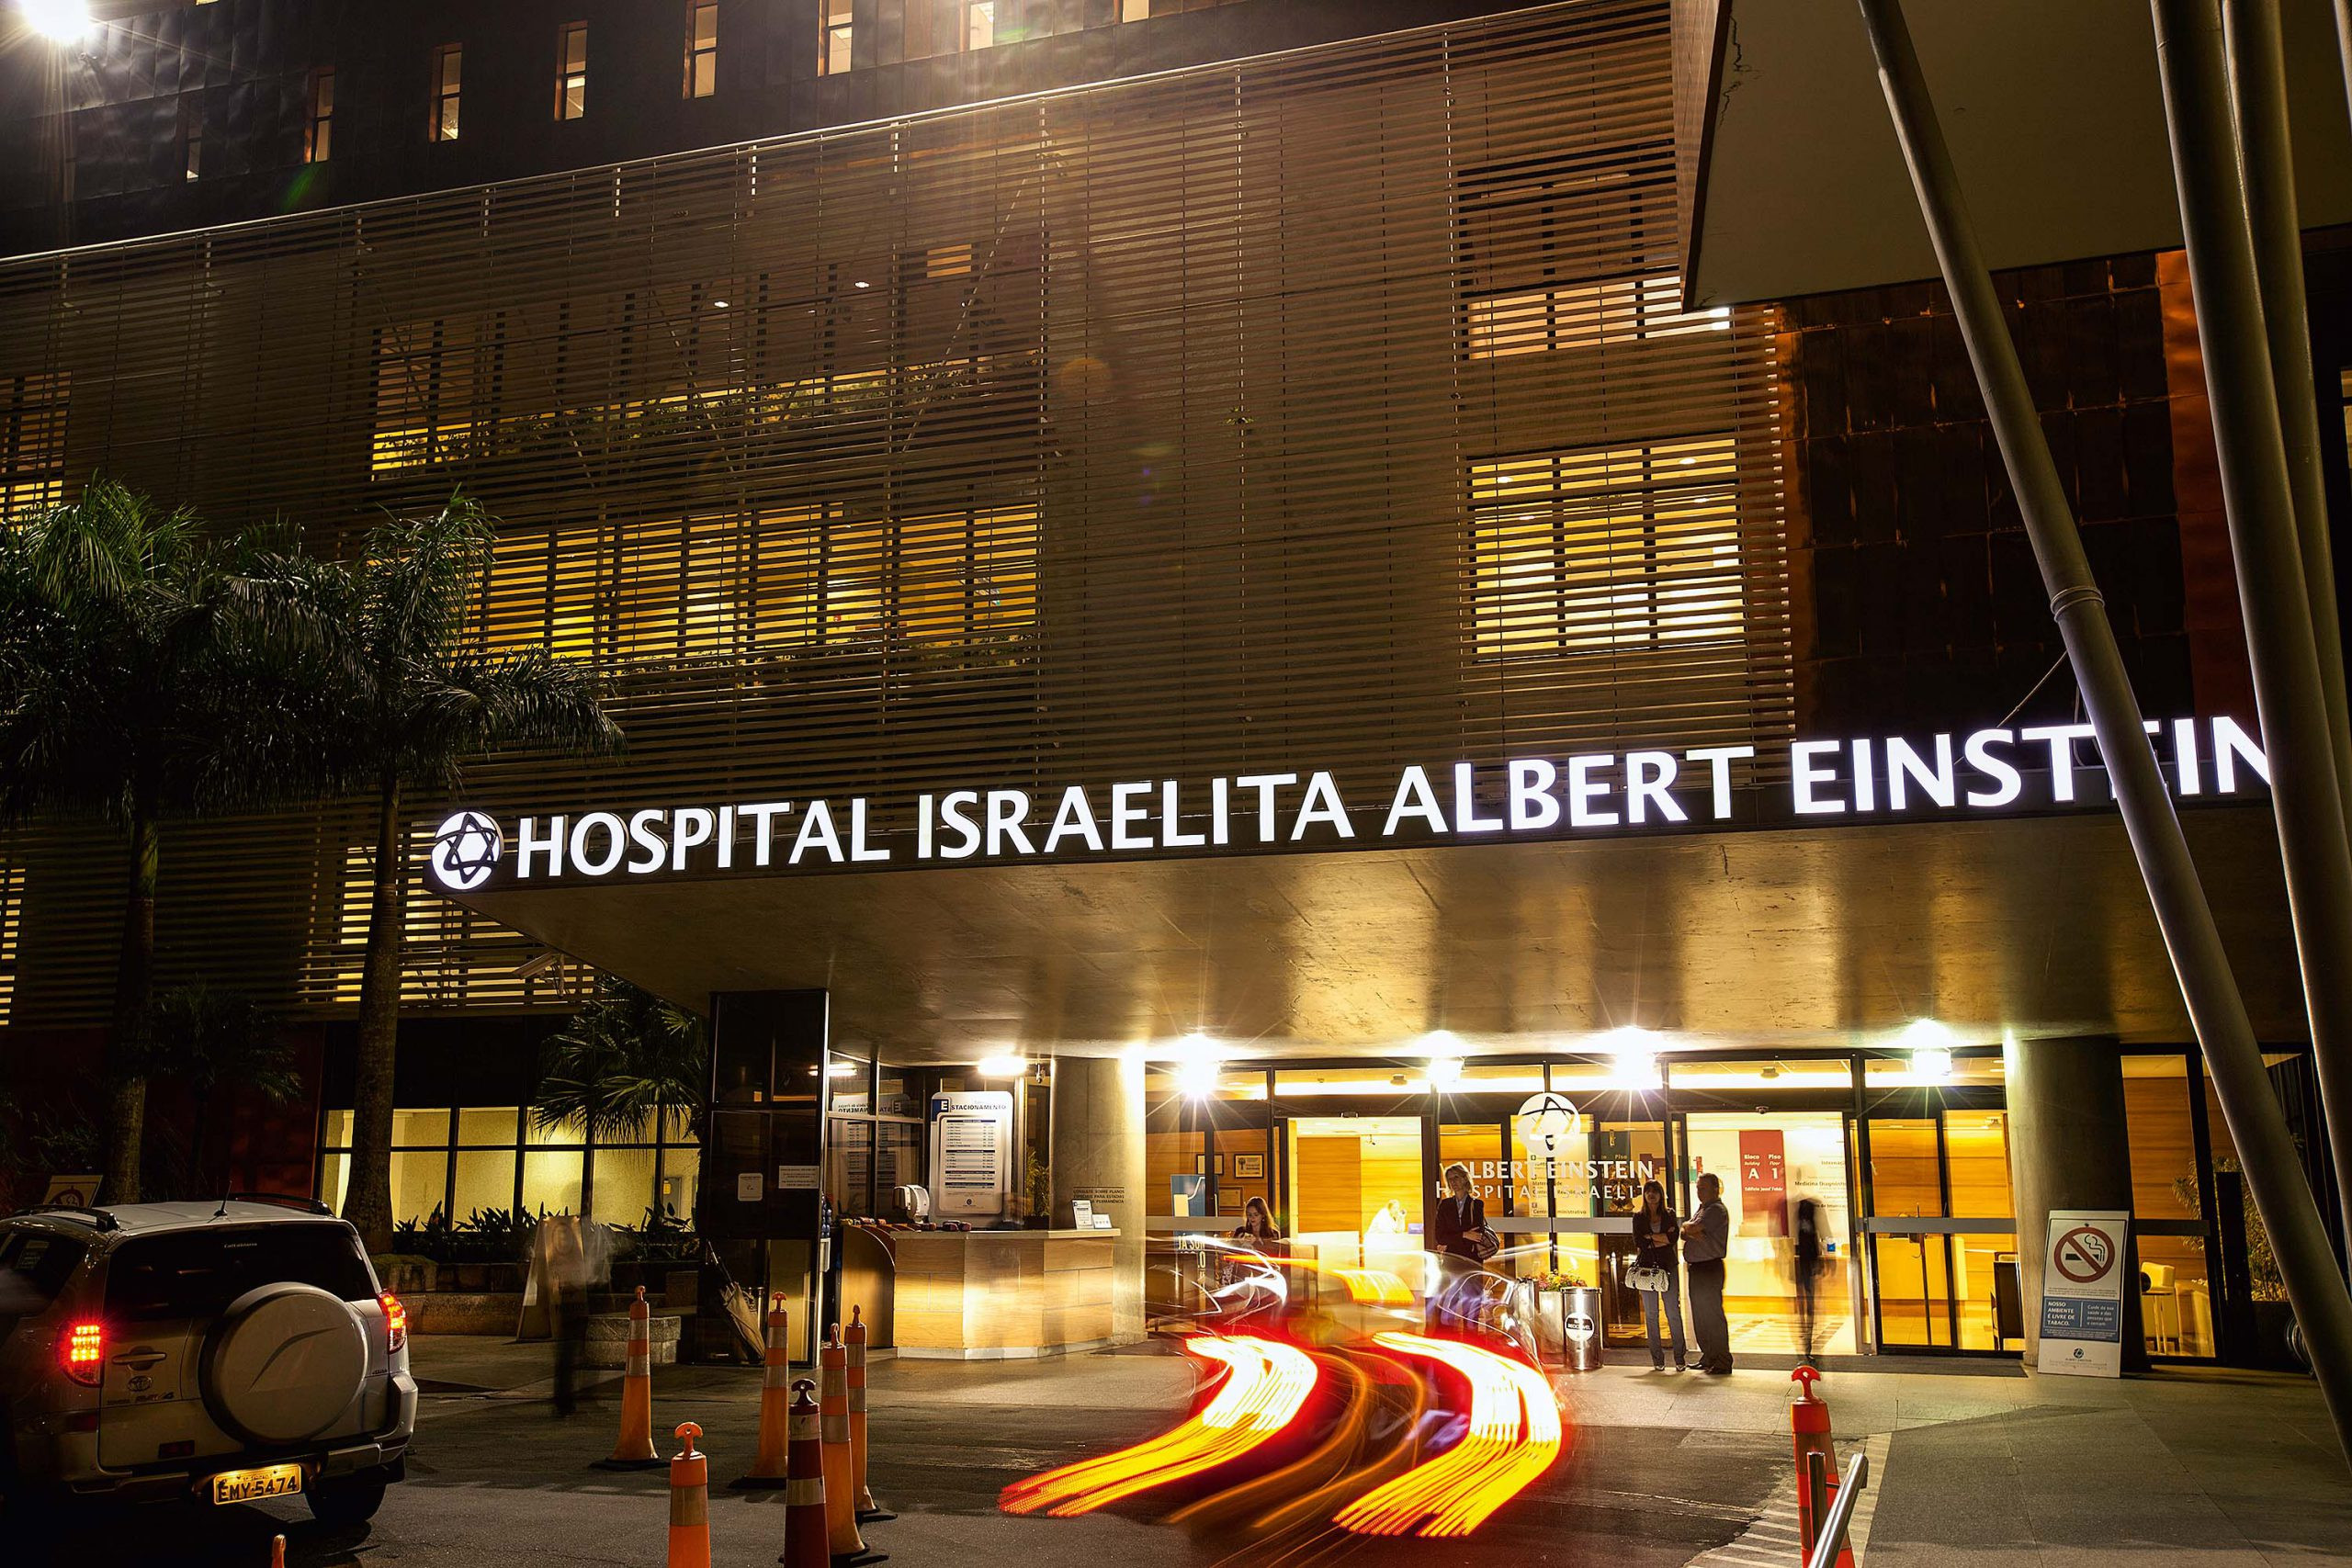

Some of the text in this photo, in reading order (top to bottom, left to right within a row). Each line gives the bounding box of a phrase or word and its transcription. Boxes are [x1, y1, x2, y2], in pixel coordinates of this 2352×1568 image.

[517, 798, 890, 878] HOSPITAL
[918, 772, 1355, 859] ISRAELITA
[1382, 747, 1755, 836] ALBERT
[1547, 1160, 1653, 1179] EINSTEIN
[1748, 1168, 1759, 1179] A
[1771, 1168, 1778, 1179] 1
